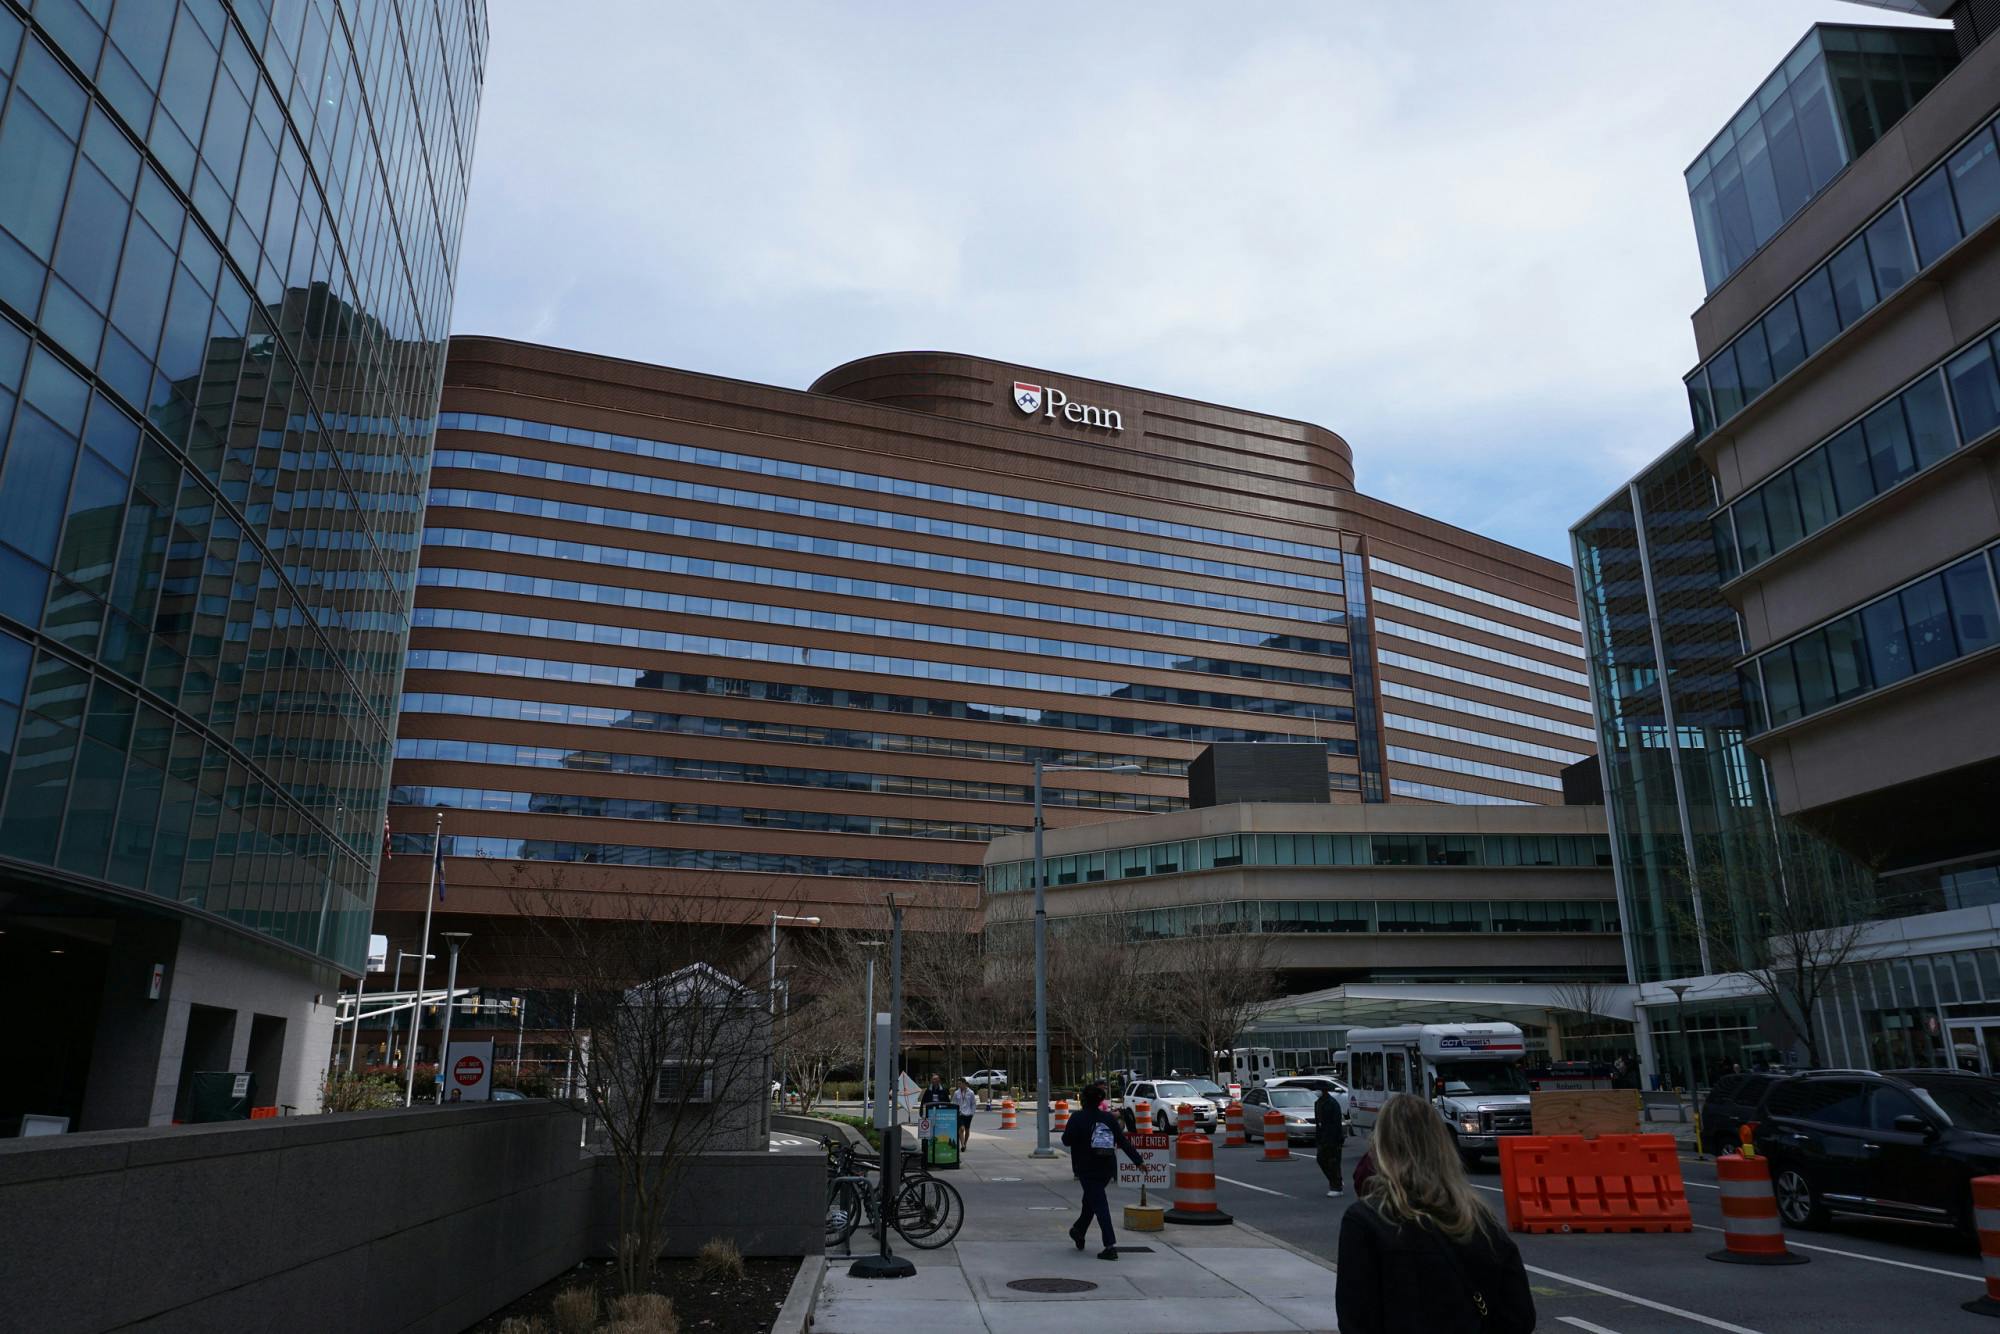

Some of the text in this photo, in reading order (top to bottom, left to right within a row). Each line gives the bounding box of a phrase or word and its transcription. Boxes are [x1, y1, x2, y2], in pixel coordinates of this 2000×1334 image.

[1044, 387, 1125, 430] Penn
[1130, 1135, 1143, 1147] NOT
[1145, 1136, 1167, 1147] ENTER
[1120, 1163, 1167, 1171] EMEENCY
[1121, 1174, 1166, 1183] NEXT RIGHT
